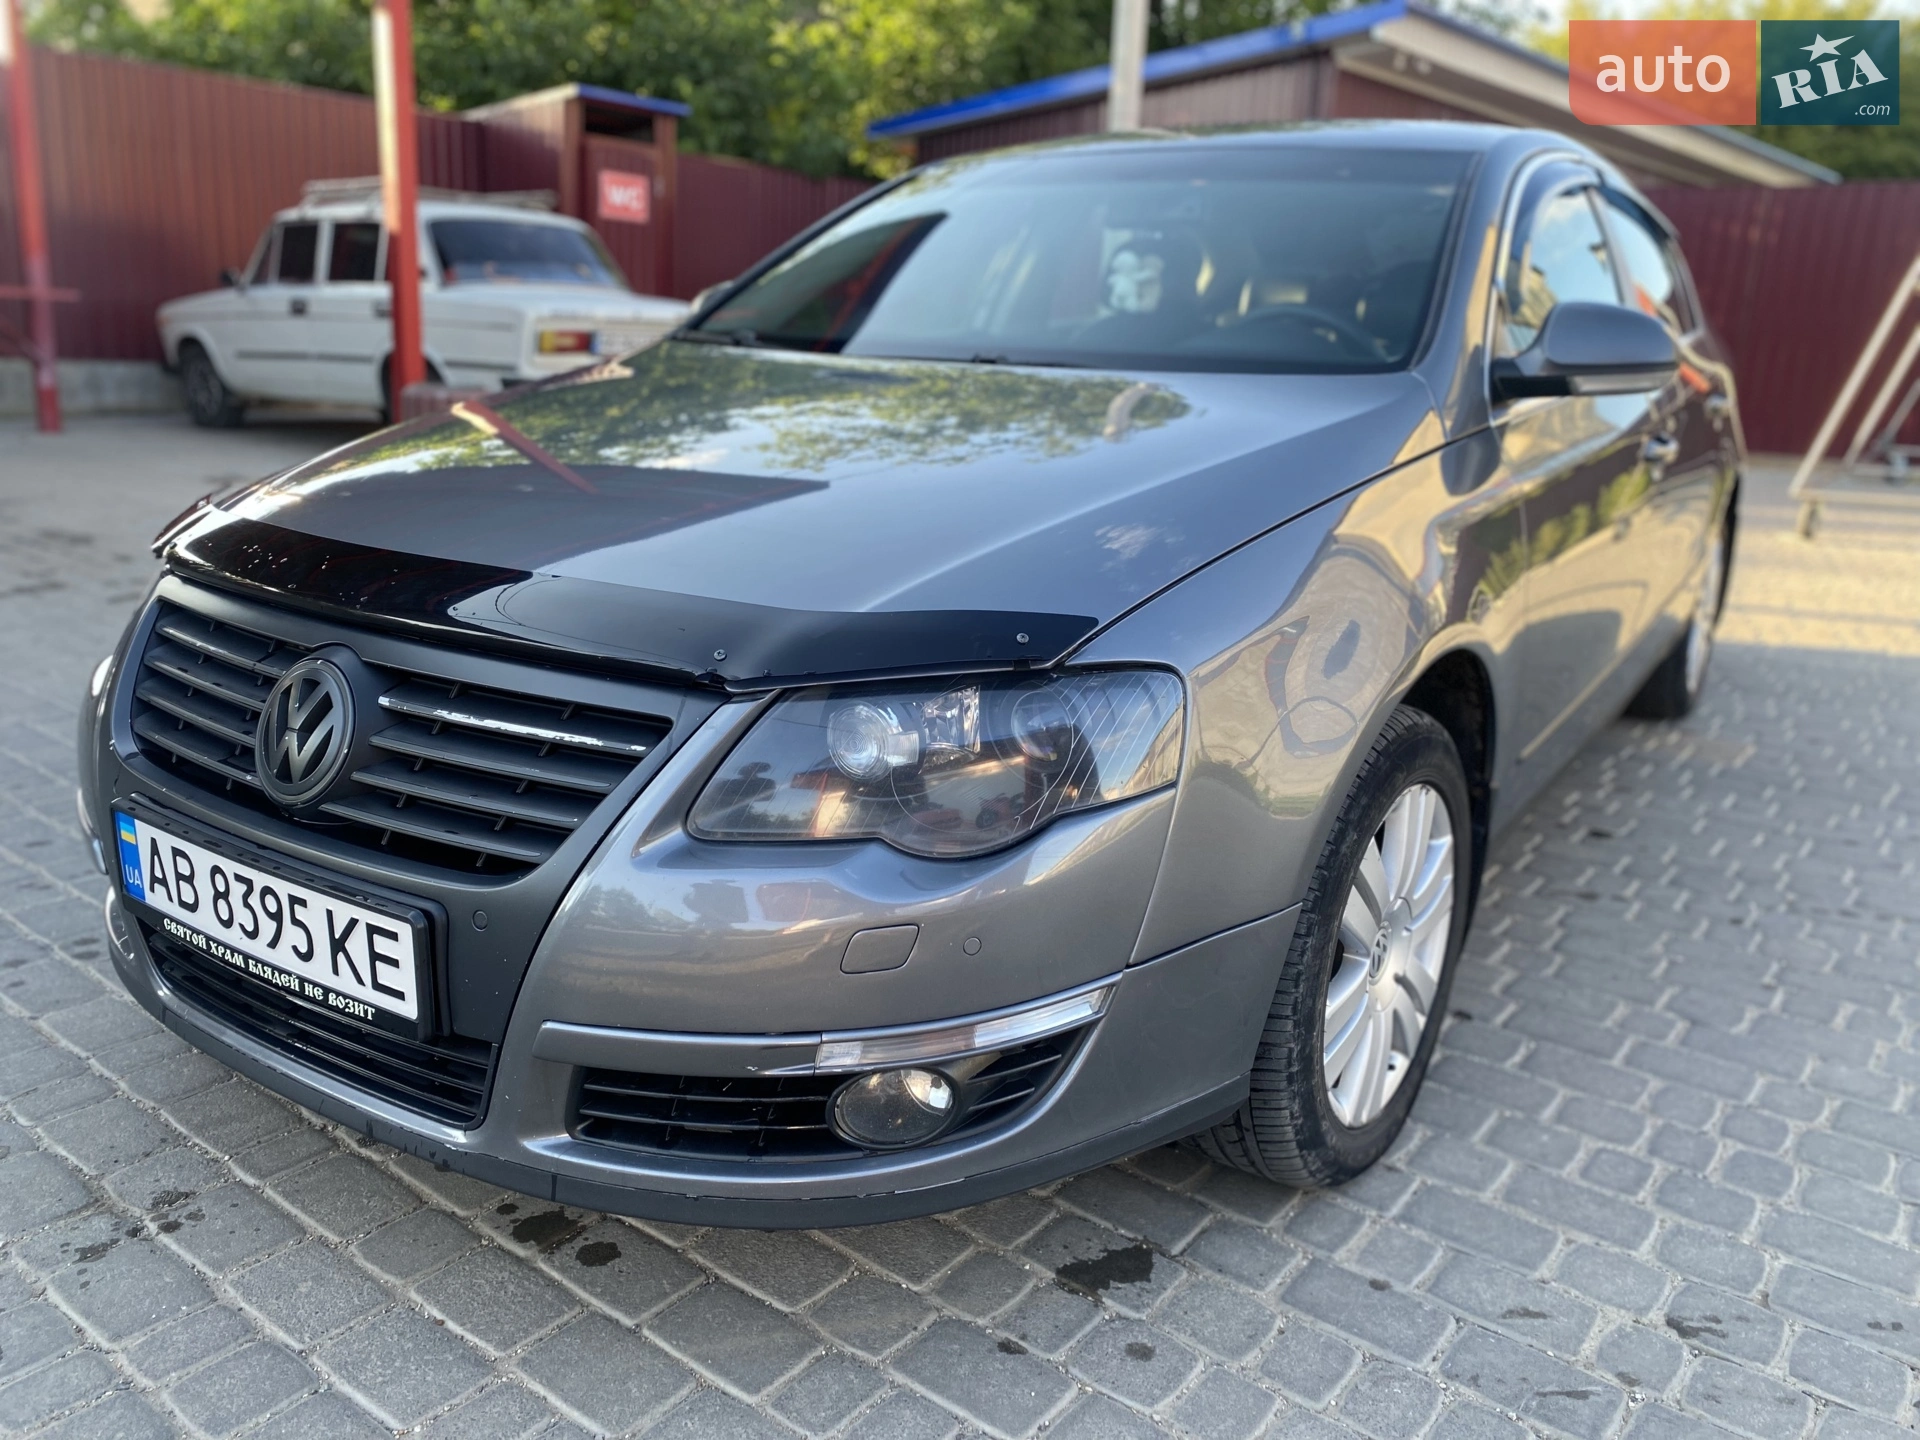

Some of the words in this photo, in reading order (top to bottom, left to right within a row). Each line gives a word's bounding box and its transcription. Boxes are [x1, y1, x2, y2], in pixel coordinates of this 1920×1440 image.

[125, 865, 143, 889] UA
[149, 836, 200, 914] AB
[209, 864, 315, 963] 8395
[326, 907, 406, 1002] KE
[163, 917, 207, 950] СВЯТОЙ
[209, 940, 246, 969] ХРАМ
[248, 958, 300, 992] БЛЯДЕЙ
[304, 981, 324, 1000] НЕ
[328, 991, 375, 1021] ВОЗИТ
